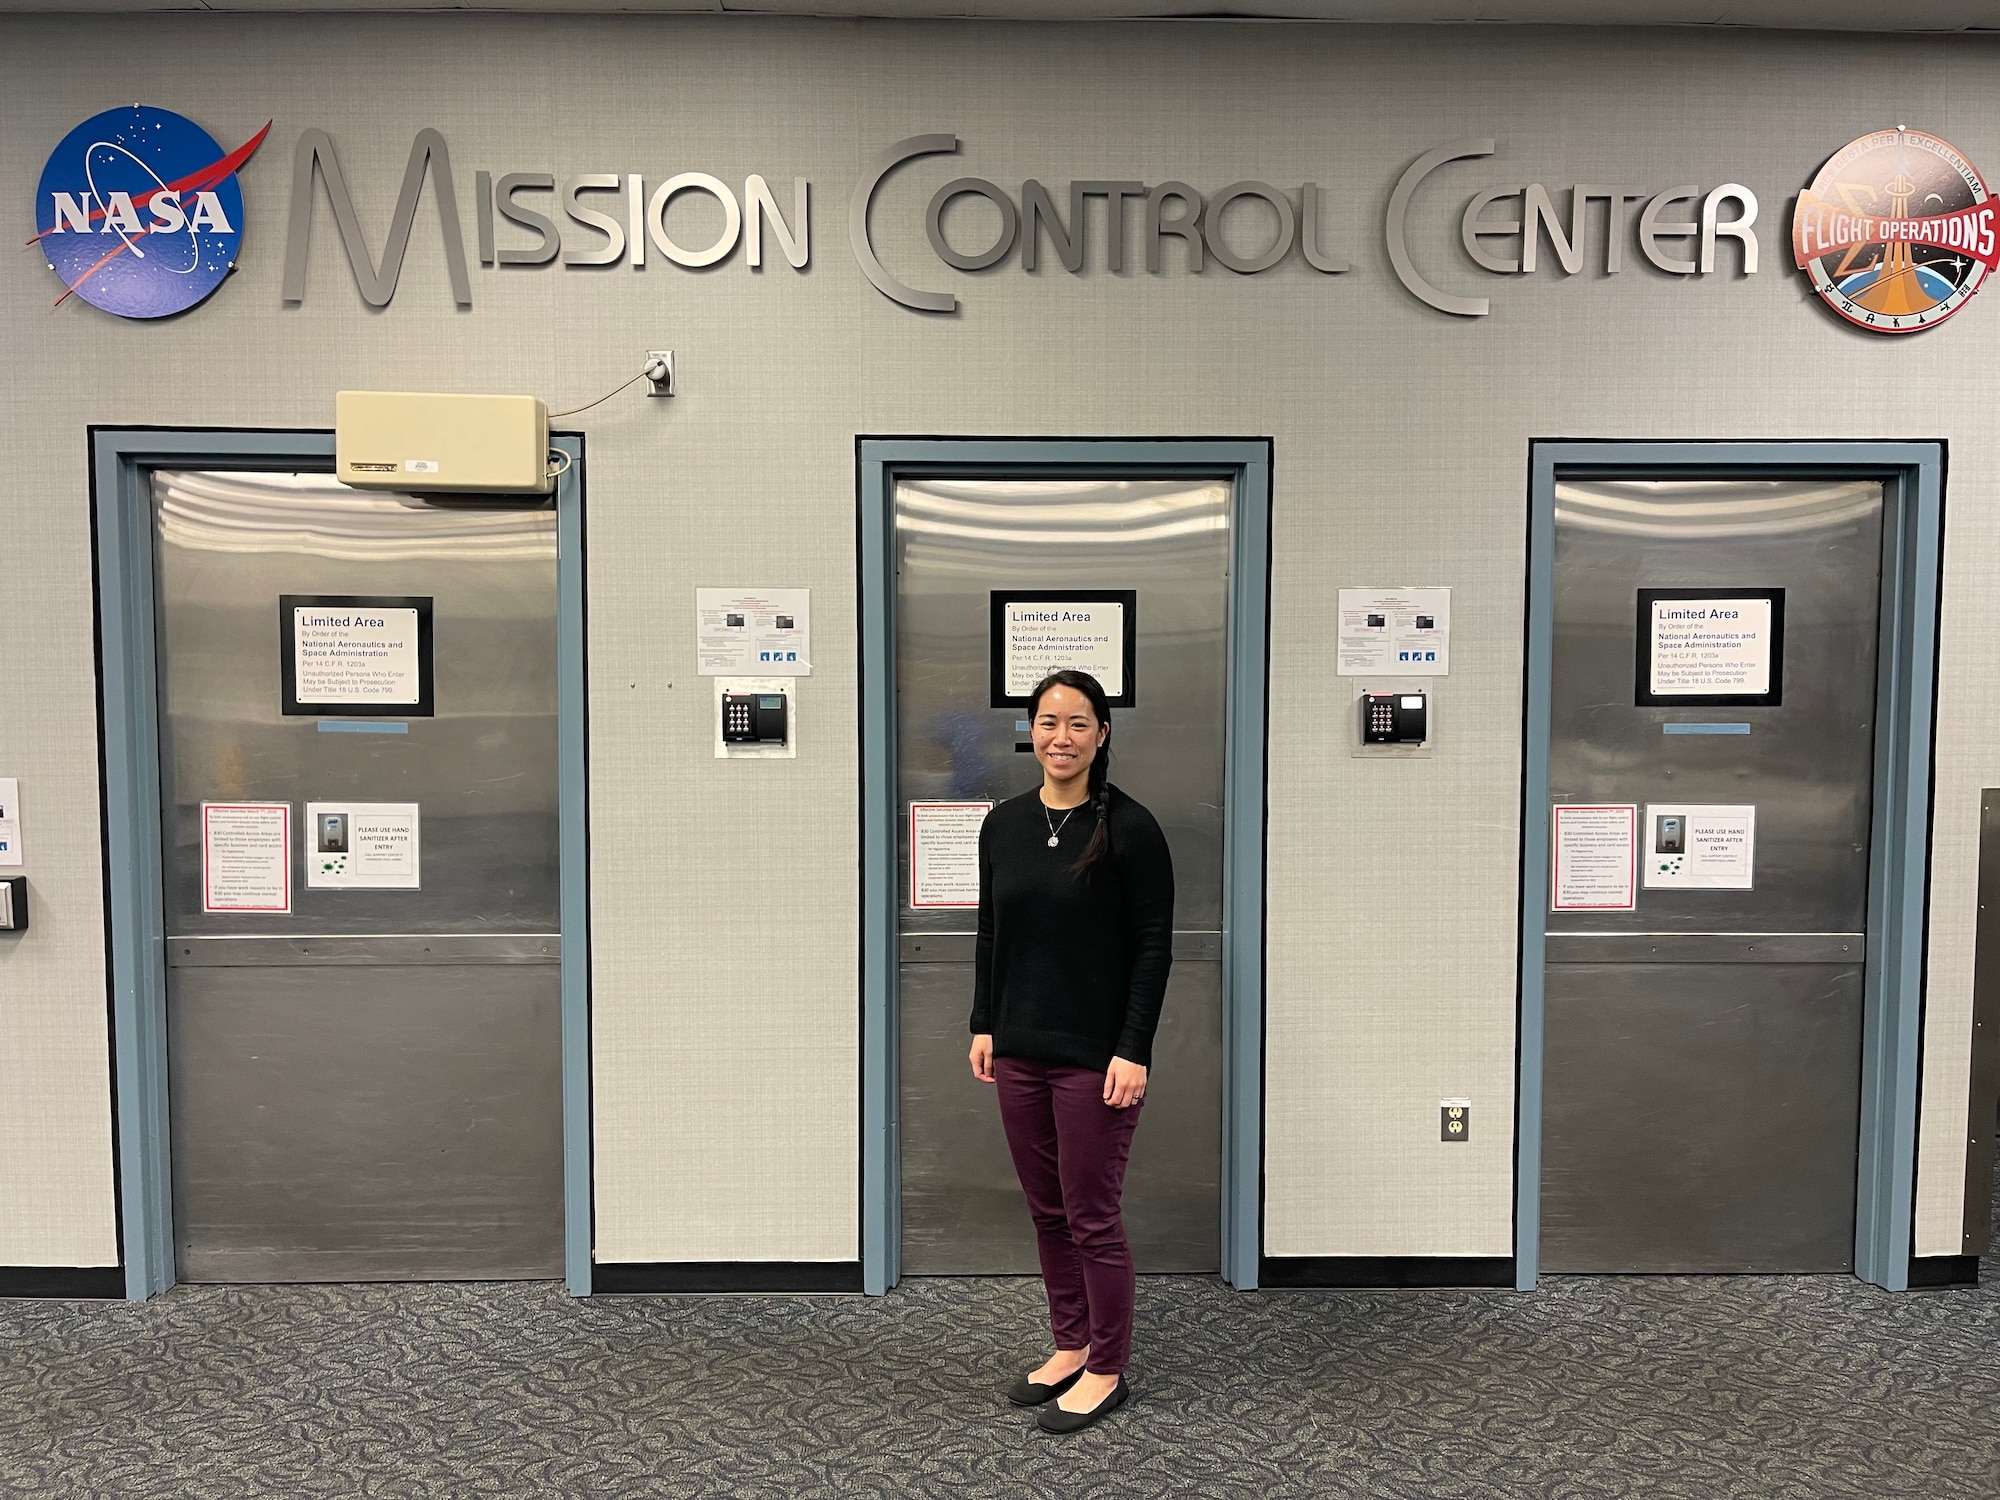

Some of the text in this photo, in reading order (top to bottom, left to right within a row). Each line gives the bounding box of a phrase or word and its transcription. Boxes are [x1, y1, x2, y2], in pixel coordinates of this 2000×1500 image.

[1817, 168, 1835, 193] RES
[1871, 134, 1894, 148] PER
[1909, 135, 1982, 195] EXCELLENTIAM
[51, 191, 235, 236] NASA
[1802, 205, 1996, 257] FLIGHT OPERATIONS
[302, 616, 384, 627] Limited Area
[1012, 611, 1091, 622] Limited Area
[1659, 609, 1739, 619] Limited Area
